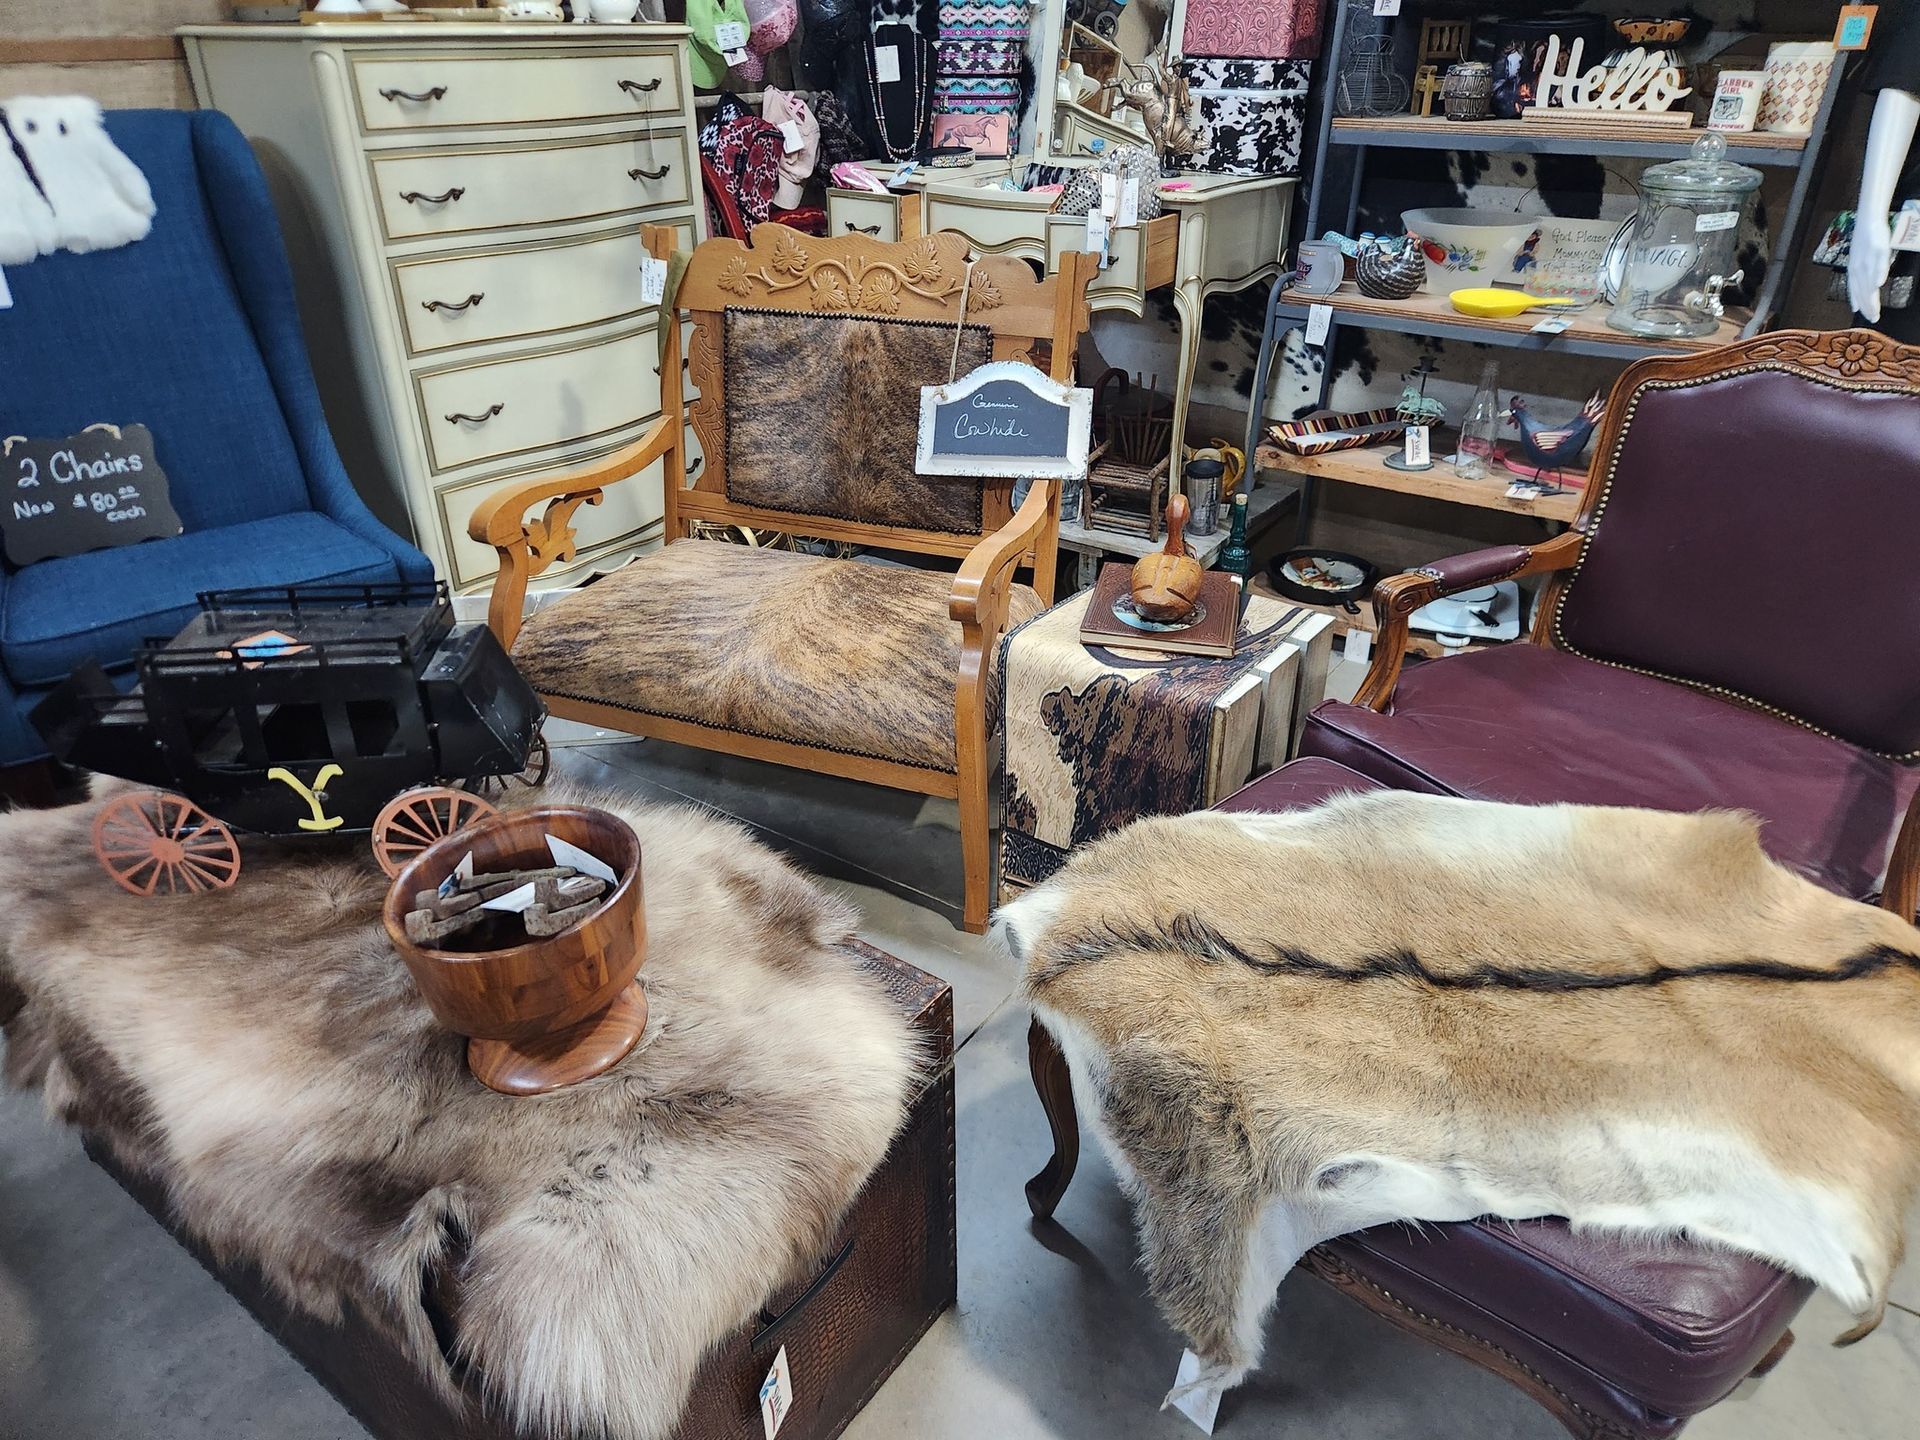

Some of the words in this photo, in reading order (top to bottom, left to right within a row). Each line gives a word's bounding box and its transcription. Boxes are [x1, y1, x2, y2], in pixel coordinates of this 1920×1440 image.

[1536, 34, 1693, 112] Hello
[1721, 87, 1741, 95] GIRL
[1552, 228, 1572, 244] God
[1576, 230, 1607, 243] Please
[954, 413, 1030, 439] Cowhide
[18, 457, 40, 487] 2
